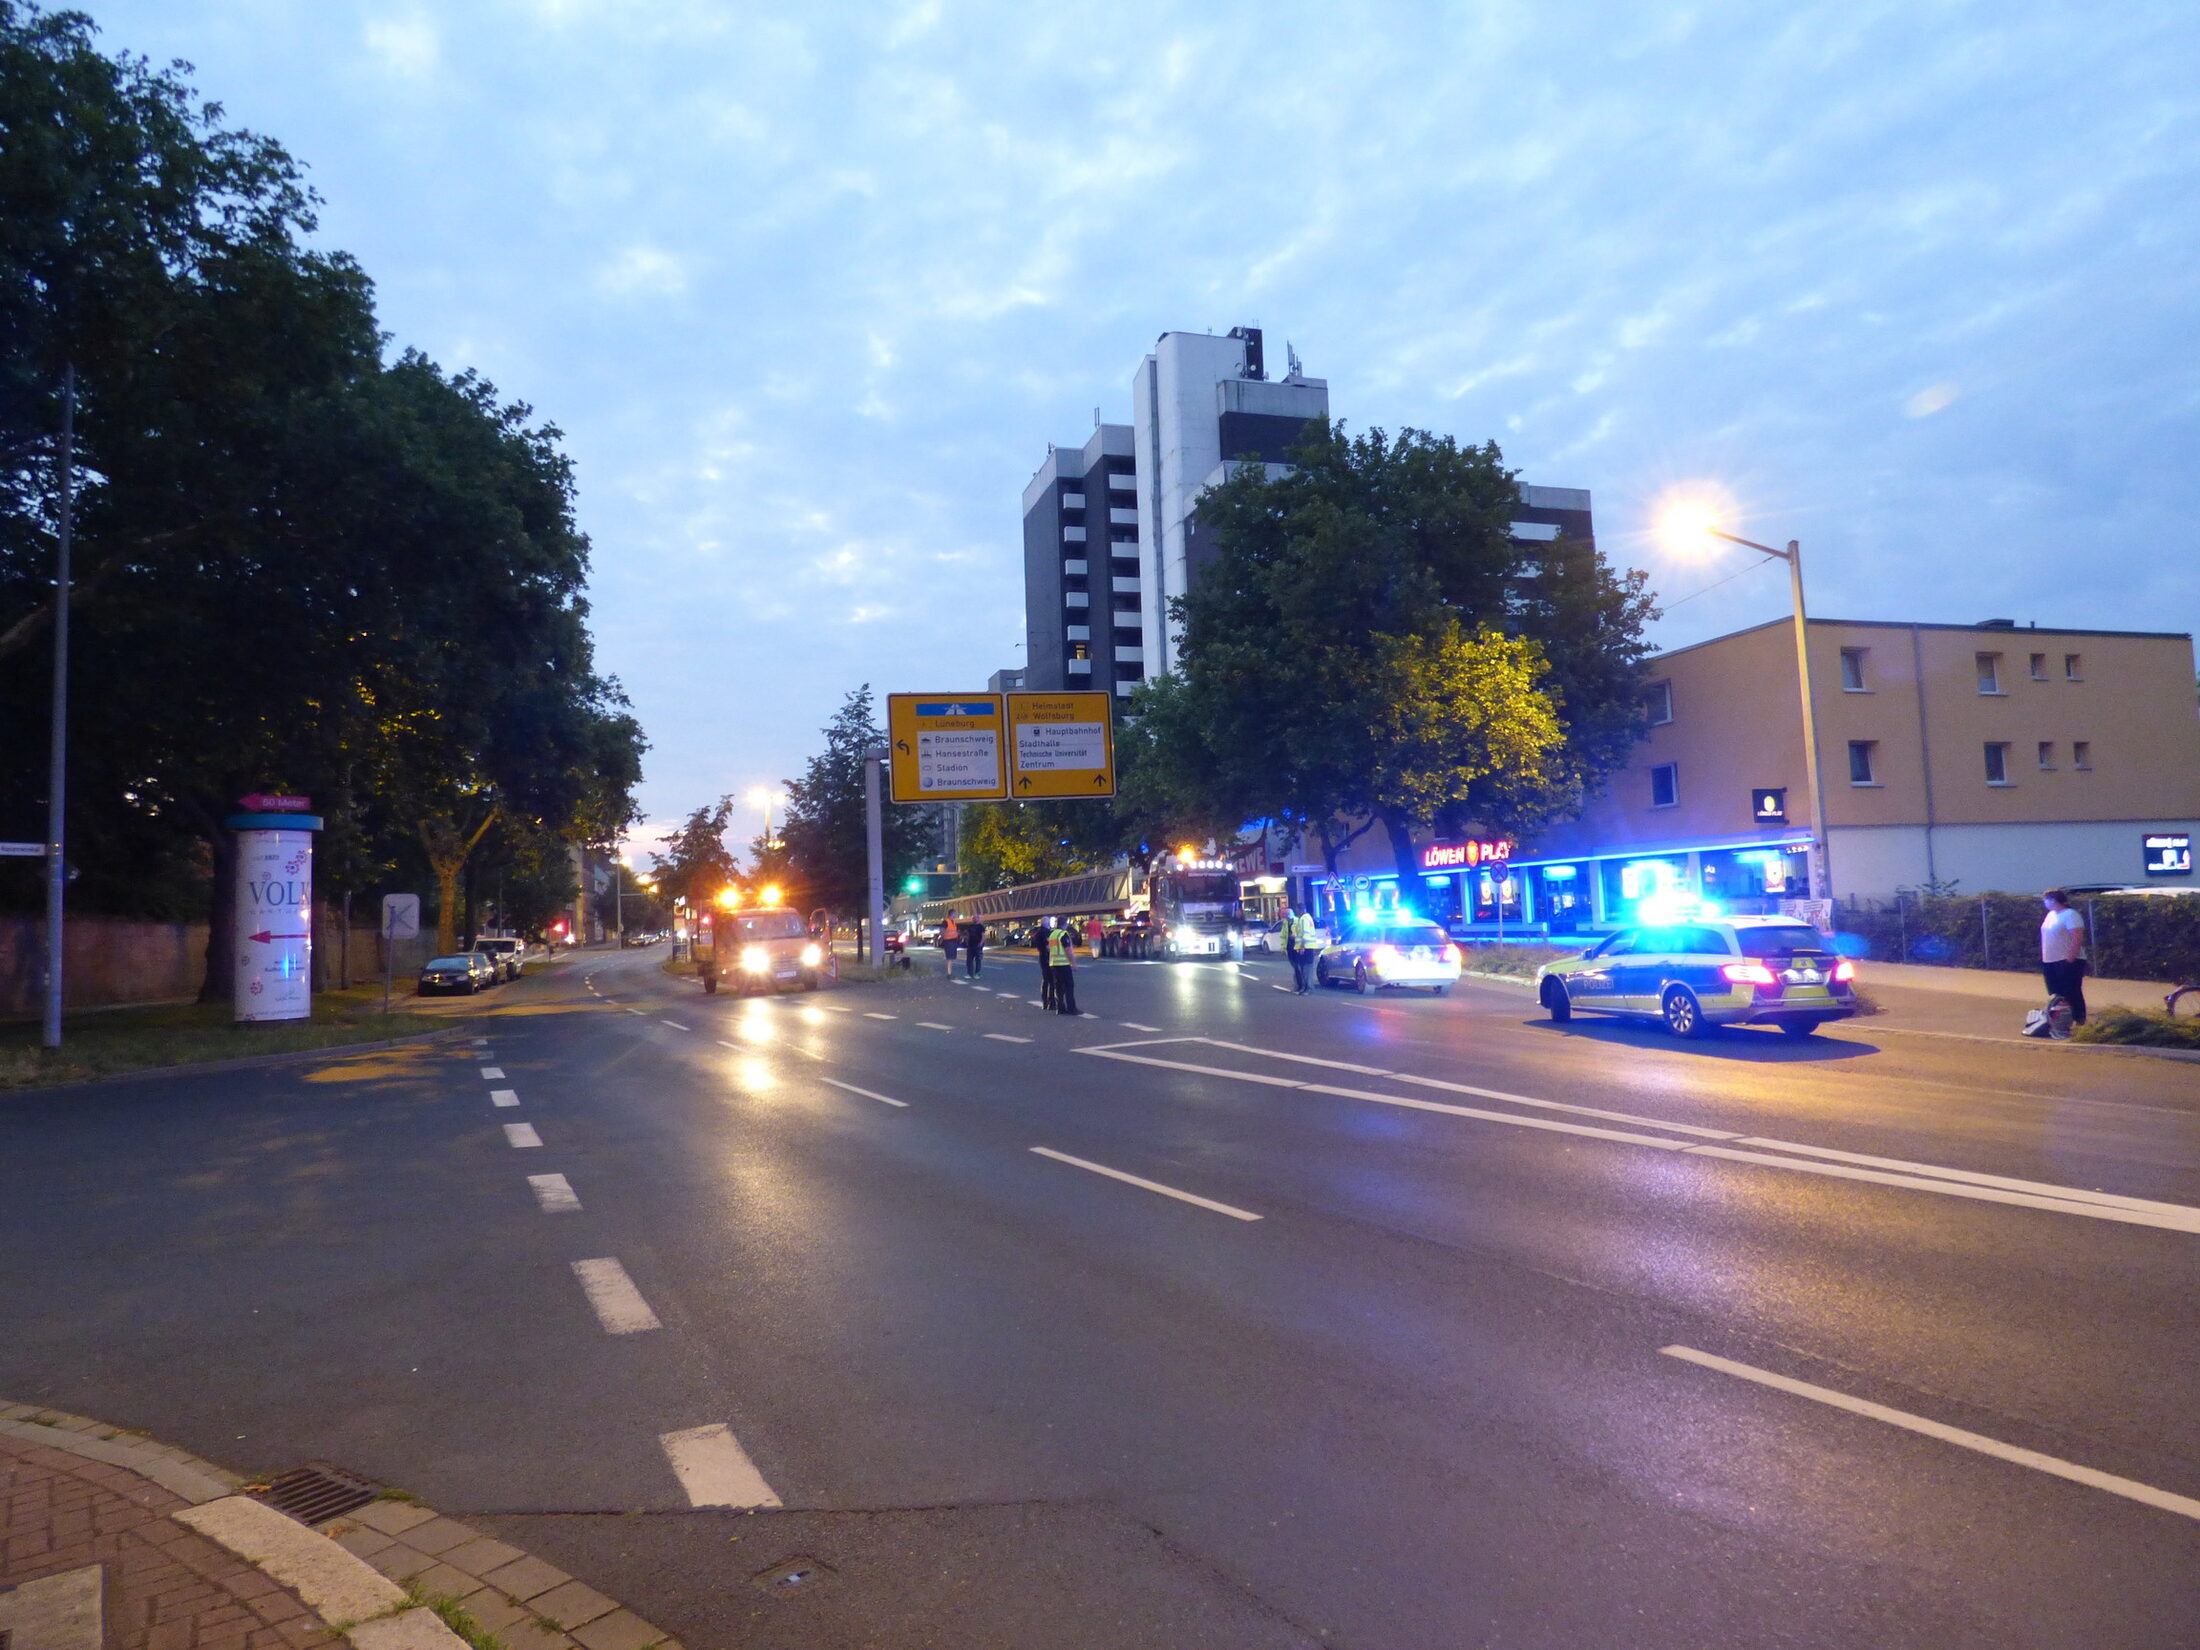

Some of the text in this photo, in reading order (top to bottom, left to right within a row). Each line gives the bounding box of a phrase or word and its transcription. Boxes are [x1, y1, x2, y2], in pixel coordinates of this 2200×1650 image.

[1032, 702, 1074, 710] Helmstedt
[1033, 712, 1075, 720] Wolfsburg
[935, 720, 975, 729] Lüneburg
[1045, 727, 1101, 736] Hauptbahnhof
[935, 736, 994, 744] Braunschweig
[1019, 740, 1060, 748] Stadthalle
[936, 749, 989, 758] Hansestraße
[1020, 750, 1052, 758] Technische
[937, 764, 968, 772] Stadion
[1020, 760, 1055, 769] Zentrum
[937, 778, 996, 787] Braunschweig
[1425, 846, 1465, 867] LÖWEN
[1583, 978, 1614, 990] POLIZEI
